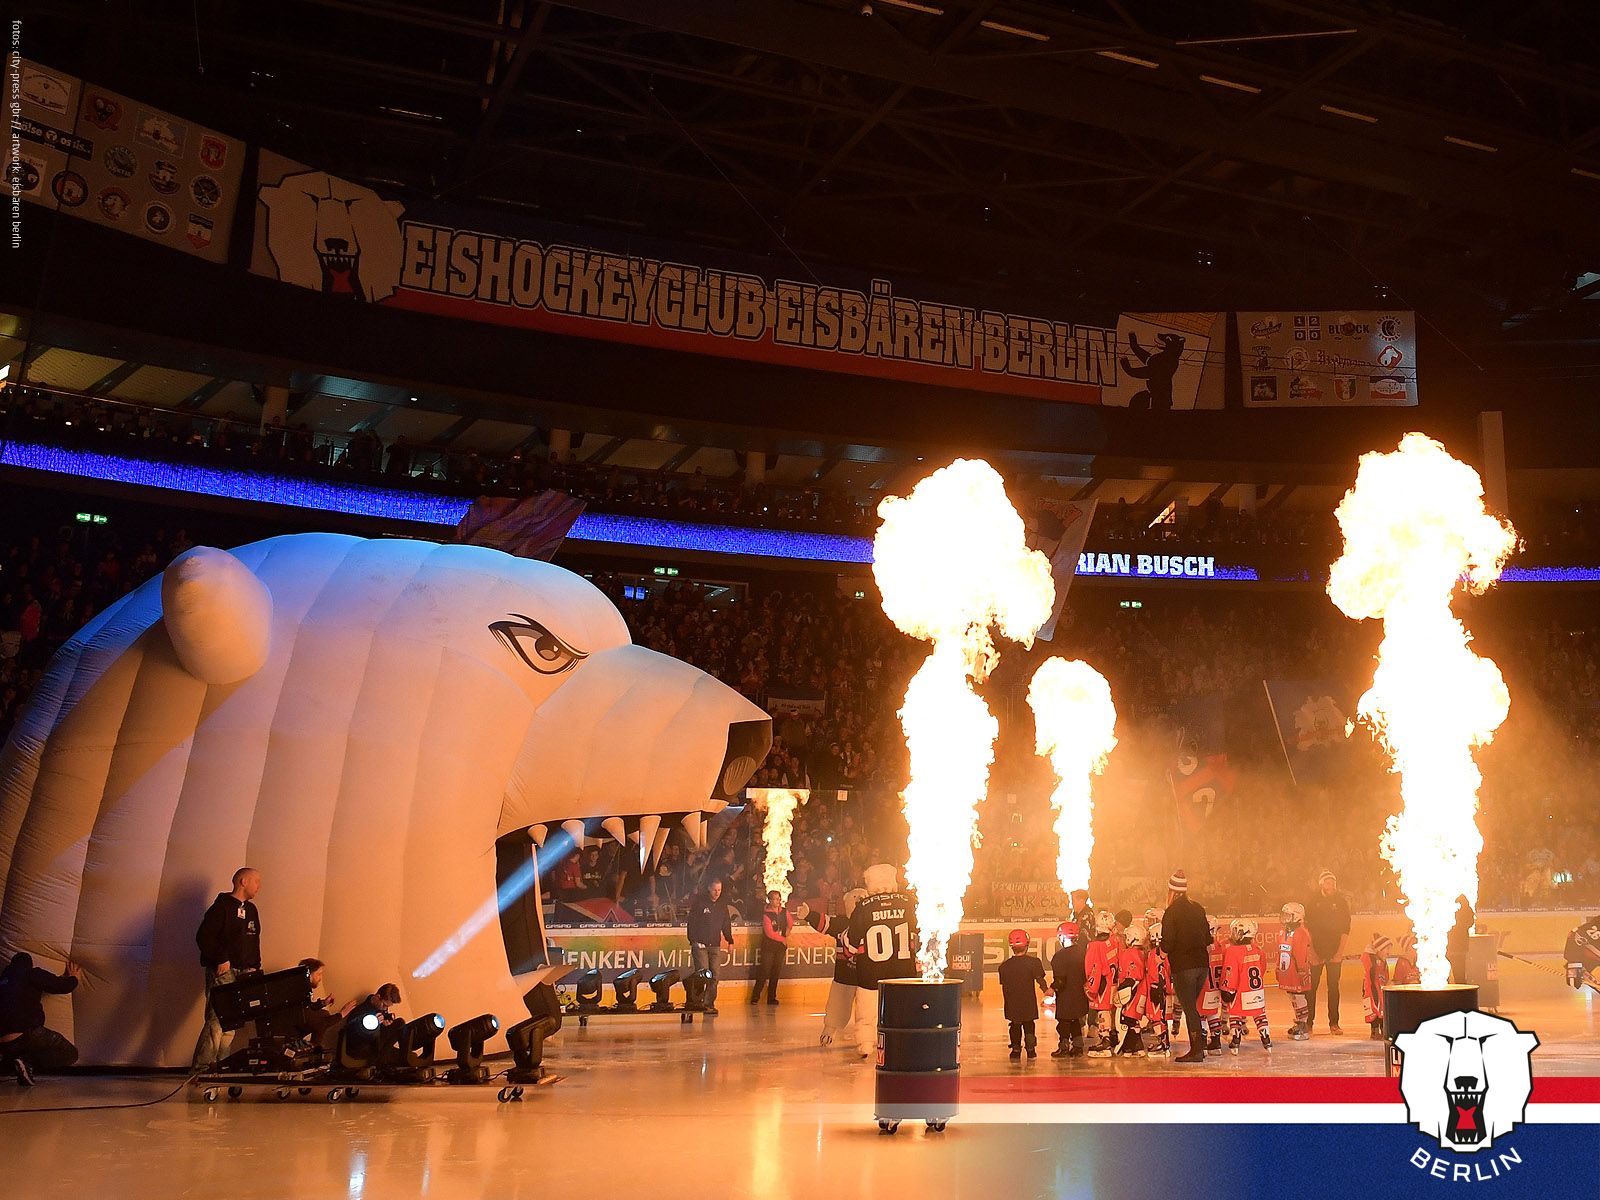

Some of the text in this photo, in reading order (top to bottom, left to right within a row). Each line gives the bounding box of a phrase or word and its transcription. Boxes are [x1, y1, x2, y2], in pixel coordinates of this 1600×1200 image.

[400, 220, 1118, 388] EISHOCKEYCLUB EISBÄREN BERLIN
[1137, 554, 1215, 577] BUSCH
[872, 908, 905, 921] BULLY
[866, 922, 911, 962] 01
[562, 950, 650, 969] ENKEN.
[1248, 966, 1263, 991] 8
